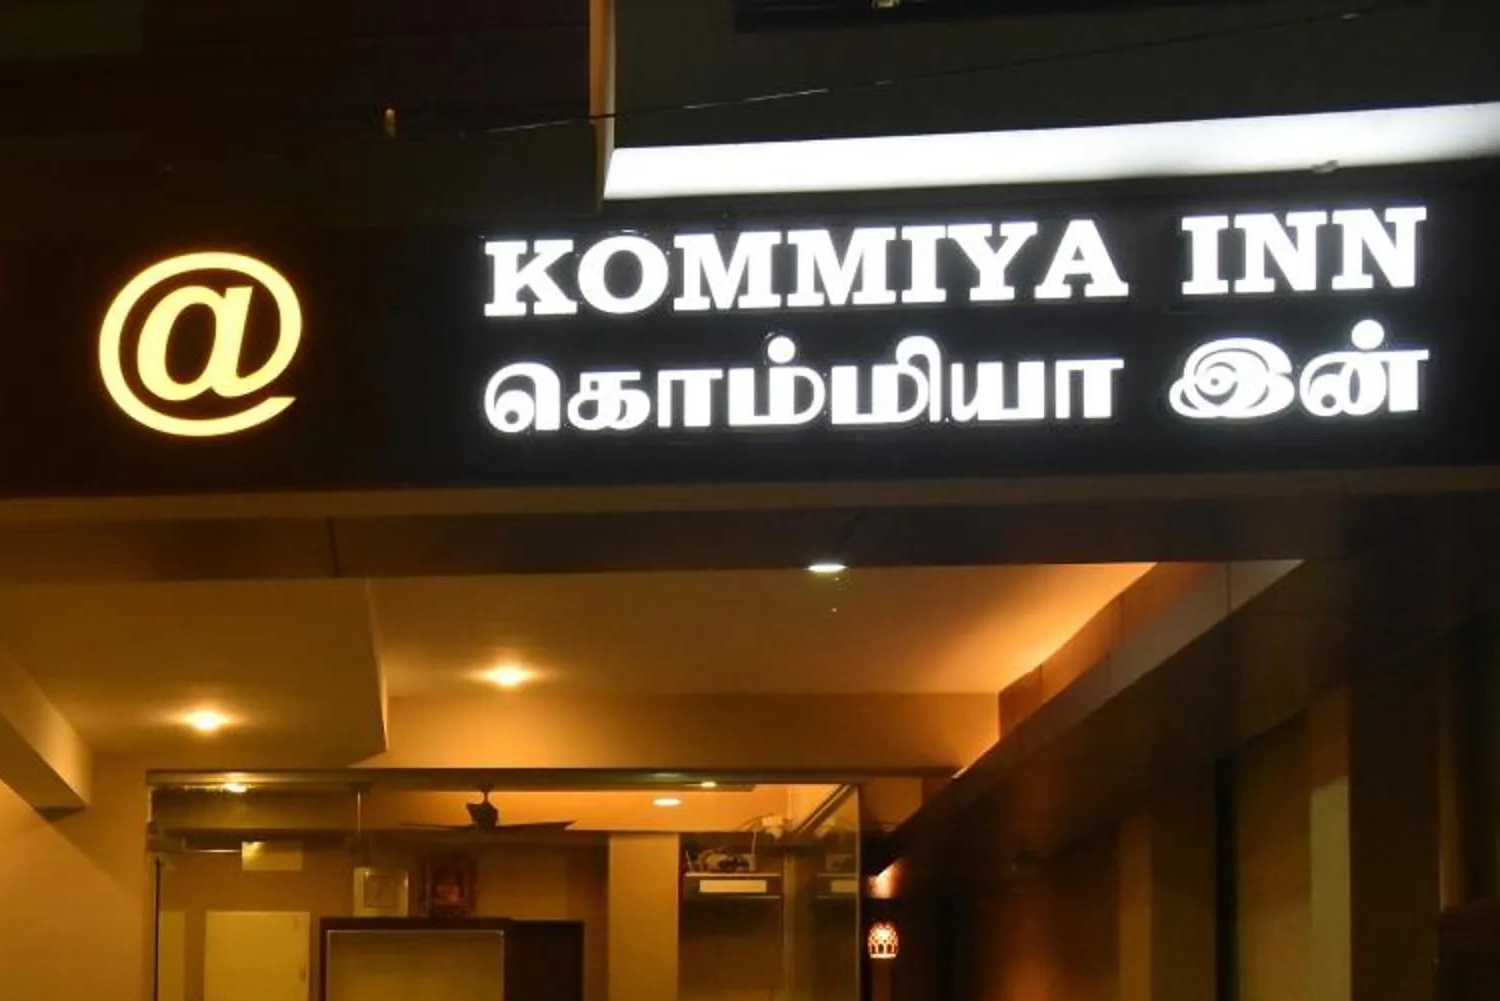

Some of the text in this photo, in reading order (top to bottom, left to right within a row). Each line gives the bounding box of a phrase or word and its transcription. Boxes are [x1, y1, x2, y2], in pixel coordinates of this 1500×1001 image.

[483, 205, 1428, 318] KOMMIYA INN
[97, 250, 303, 438] @
[482, 318, 1431, 434] கொம்மியா இன்
